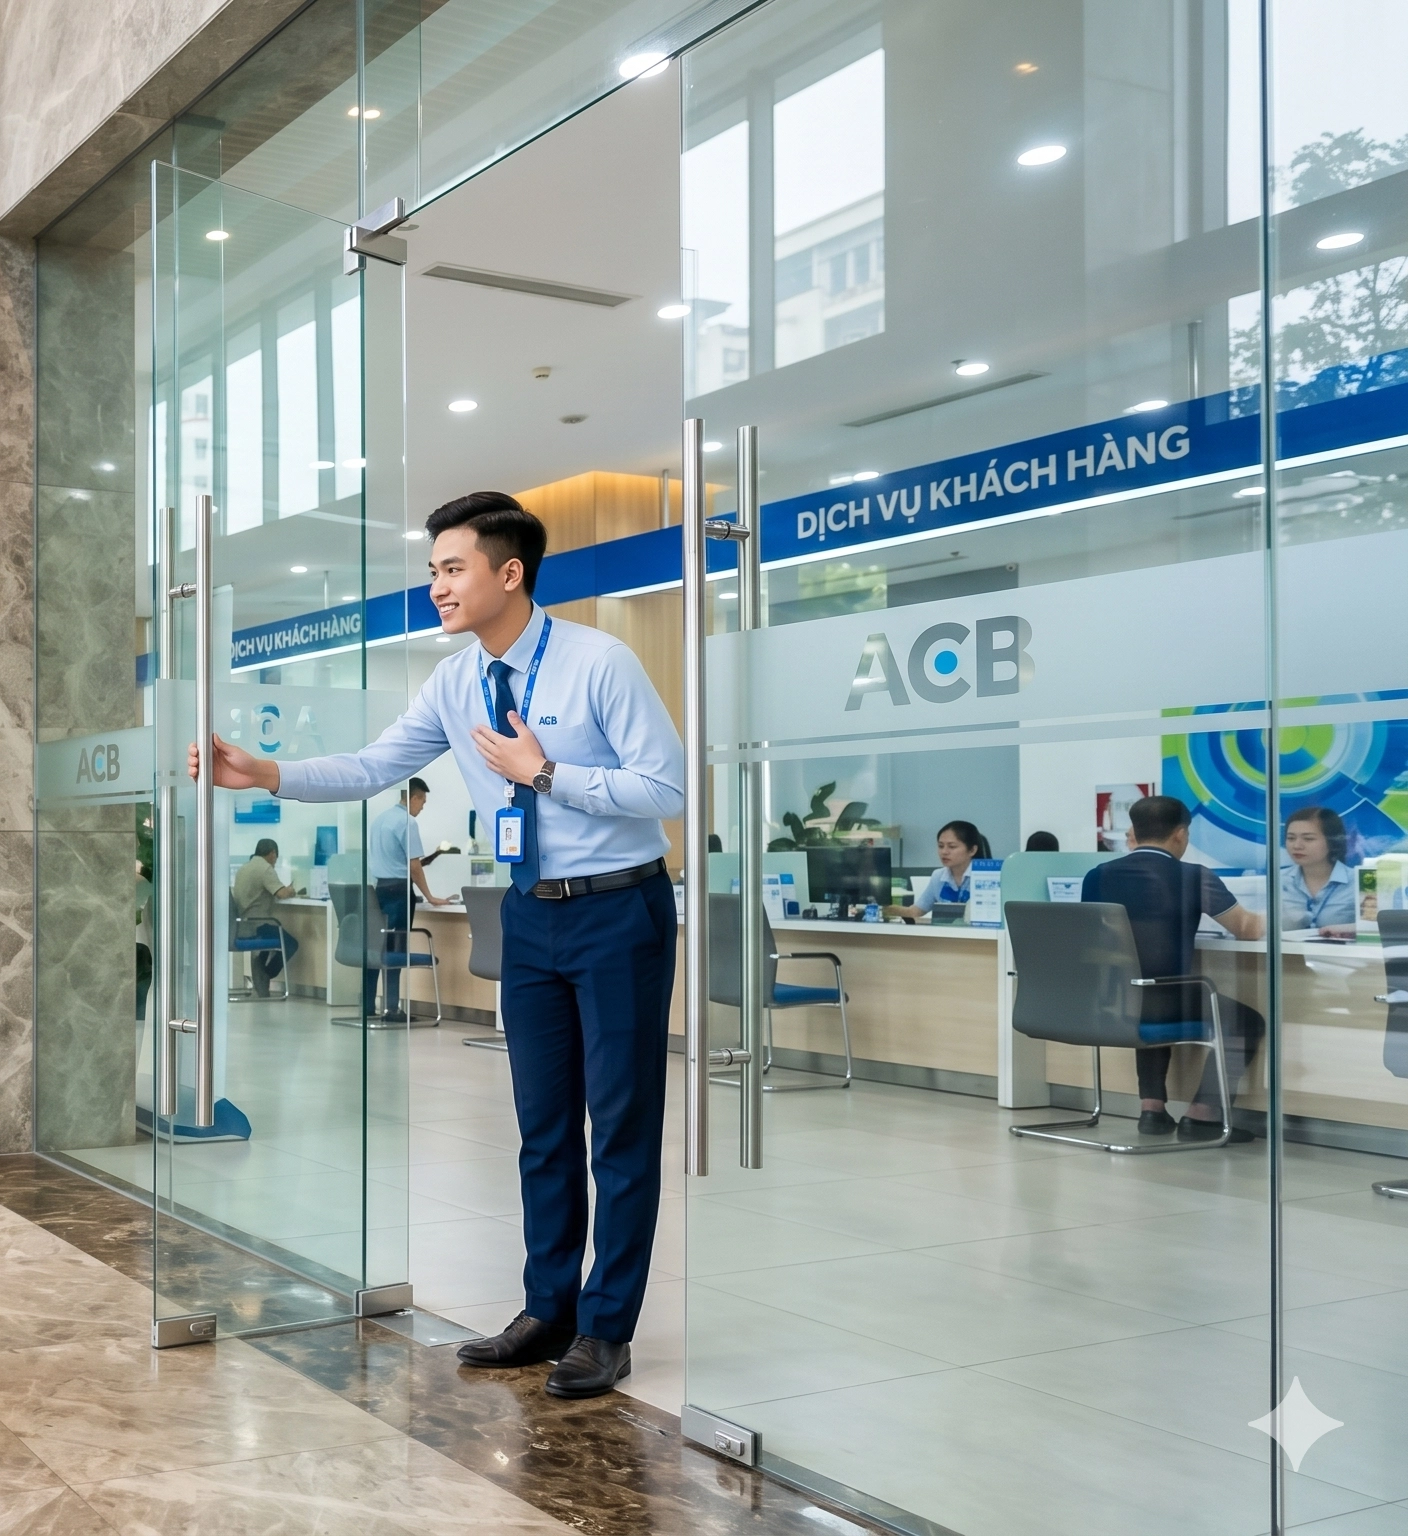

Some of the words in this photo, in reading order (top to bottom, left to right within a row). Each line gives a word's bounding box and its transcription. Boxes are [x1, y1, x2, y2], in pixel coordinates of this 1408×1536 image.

[797, 497, 870, 541] DỊCH
[876, 485, 922, 524] VỤ
[929, 453, 1057, 511] KHÁCH
[1067, 425, 1190, 481] HÀNG
[255, 633, 273, 656] VỤ
[274, 623, 319, 650] KHÁCH
[320, 613, 361, 640] HÀNG
[844, 615, 1036, 711] ACB
[75, 743, 121, 784] ACB
